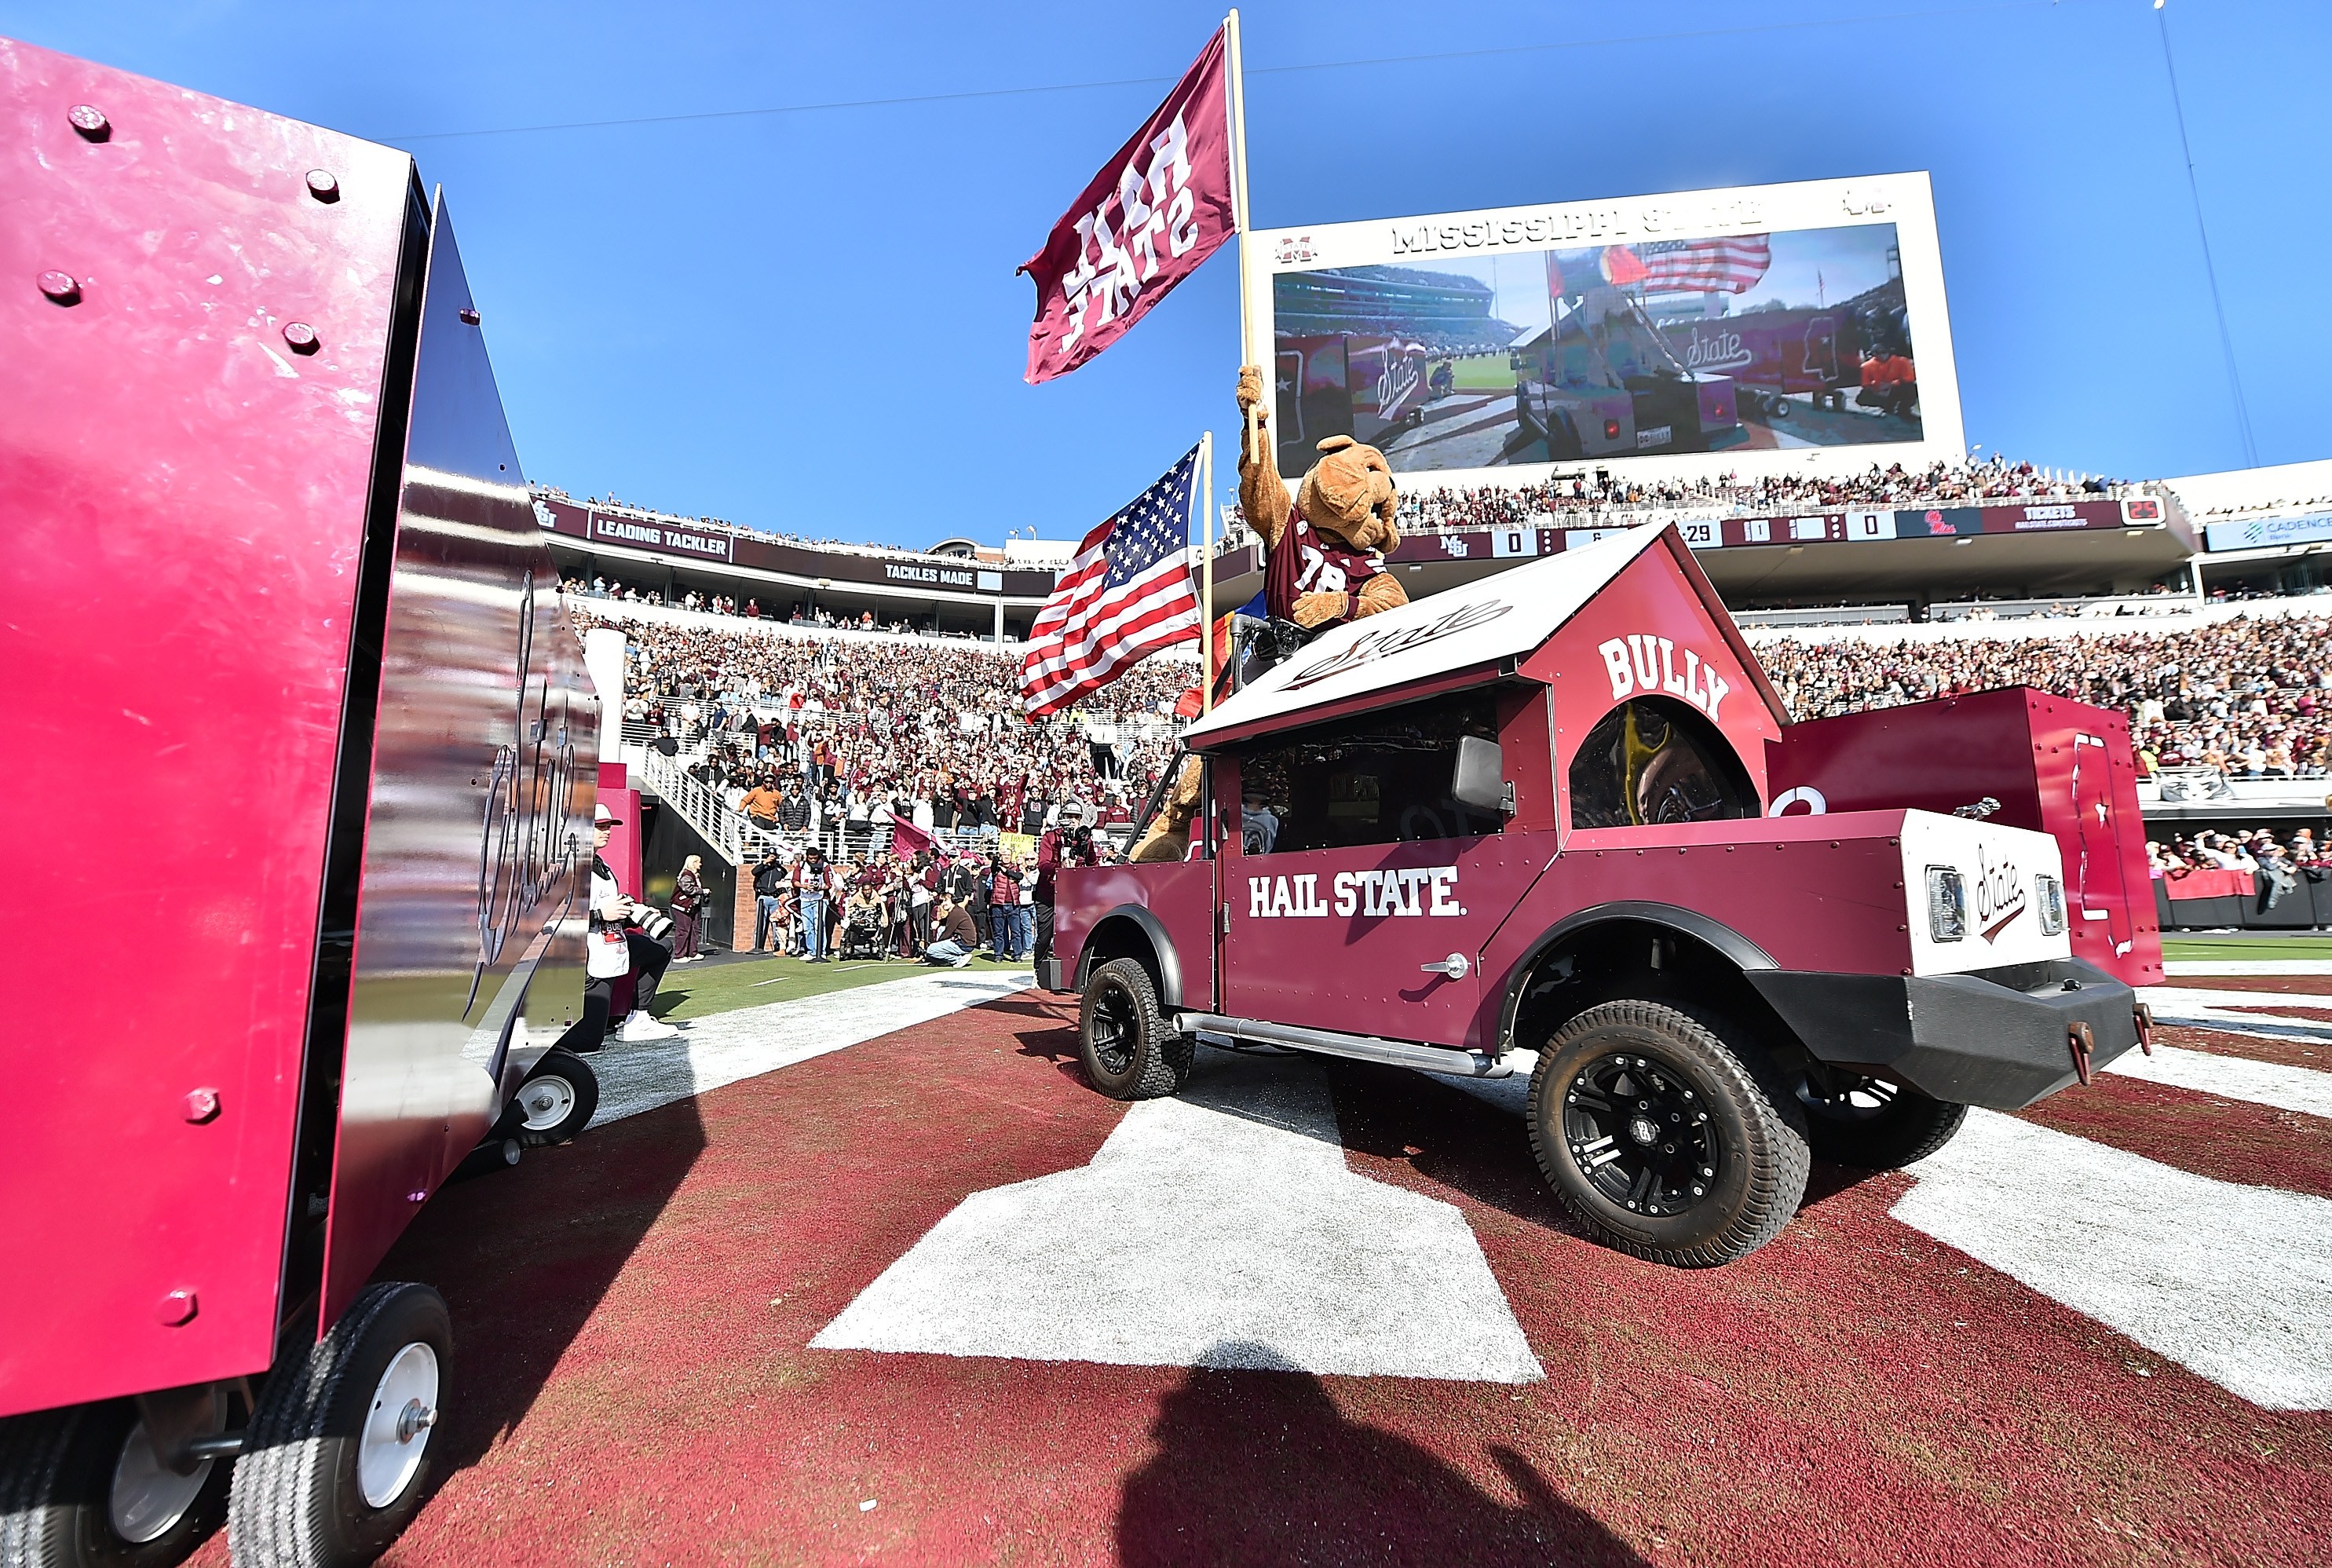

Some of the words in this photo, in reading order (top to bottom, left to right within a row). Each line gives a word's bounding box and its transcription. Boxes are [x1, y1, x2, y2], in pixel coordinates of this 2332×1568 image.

[1391, 209, 1628, 254] MISSISSIPPI
[1687, 327, 1753, 375] State
[1377, 348, 1419, 421] State
[1864, 515, 1878, 535] 0
[2023, 505, 2076, 521] TICKETS
[2129, 501, 2158, 519] 25
[596, 519, 661, 544] LEADING
[663, 530, 727, 555] TACKLER
[1508, 533, 1522, 553] 0
[885, 564, 938, 583] TACKLES
[940, 570, 974, 586] MADE
[1271, 598, 1514, 693] State
[1597, 633, 1730, 723] BULLY
[1248, 873, 1329, 917] HAIL
[1976, 842, 2027, 946] State
